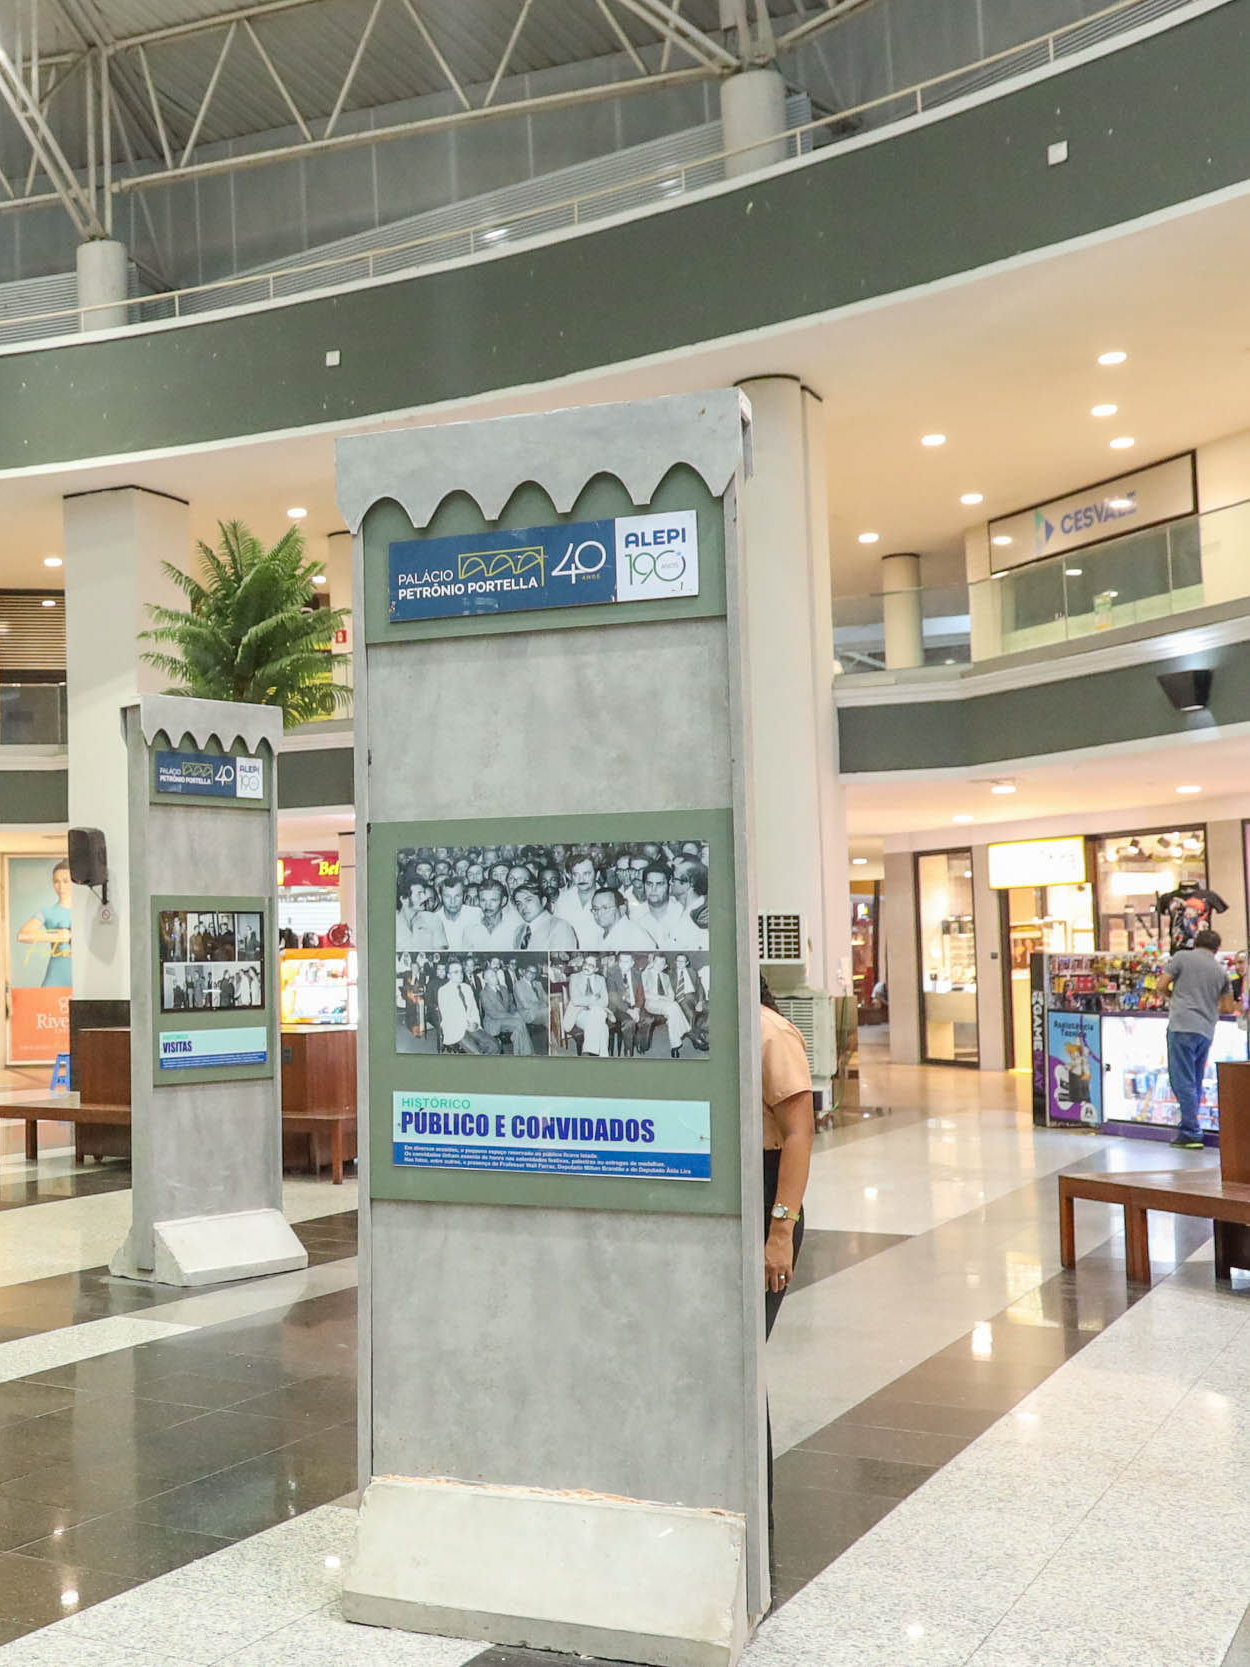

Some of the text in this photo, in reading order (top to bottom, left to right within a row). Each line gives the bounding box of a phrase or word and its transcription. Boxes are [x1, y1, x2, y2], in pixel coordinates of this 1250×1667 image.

[1060, 490, 1136, 534] CESVAE
[625, 528, 686, 548] ALEPI
[551, 540, 607, 584] 40
[624, 550, 686, 585] 190
[398, 569, 453, 586] PALÁCIO
[398, 577, 538, 600] PETRÔNIO PORTELLA
[215, 765, 235, 786] 40
[162, 1040, 192, 1054] VISITAS
[402, 1096, 470, 1110] HISTÓRICO
[401, 1108, 655, 1143] PÚBLICO E CONVIDADOS
